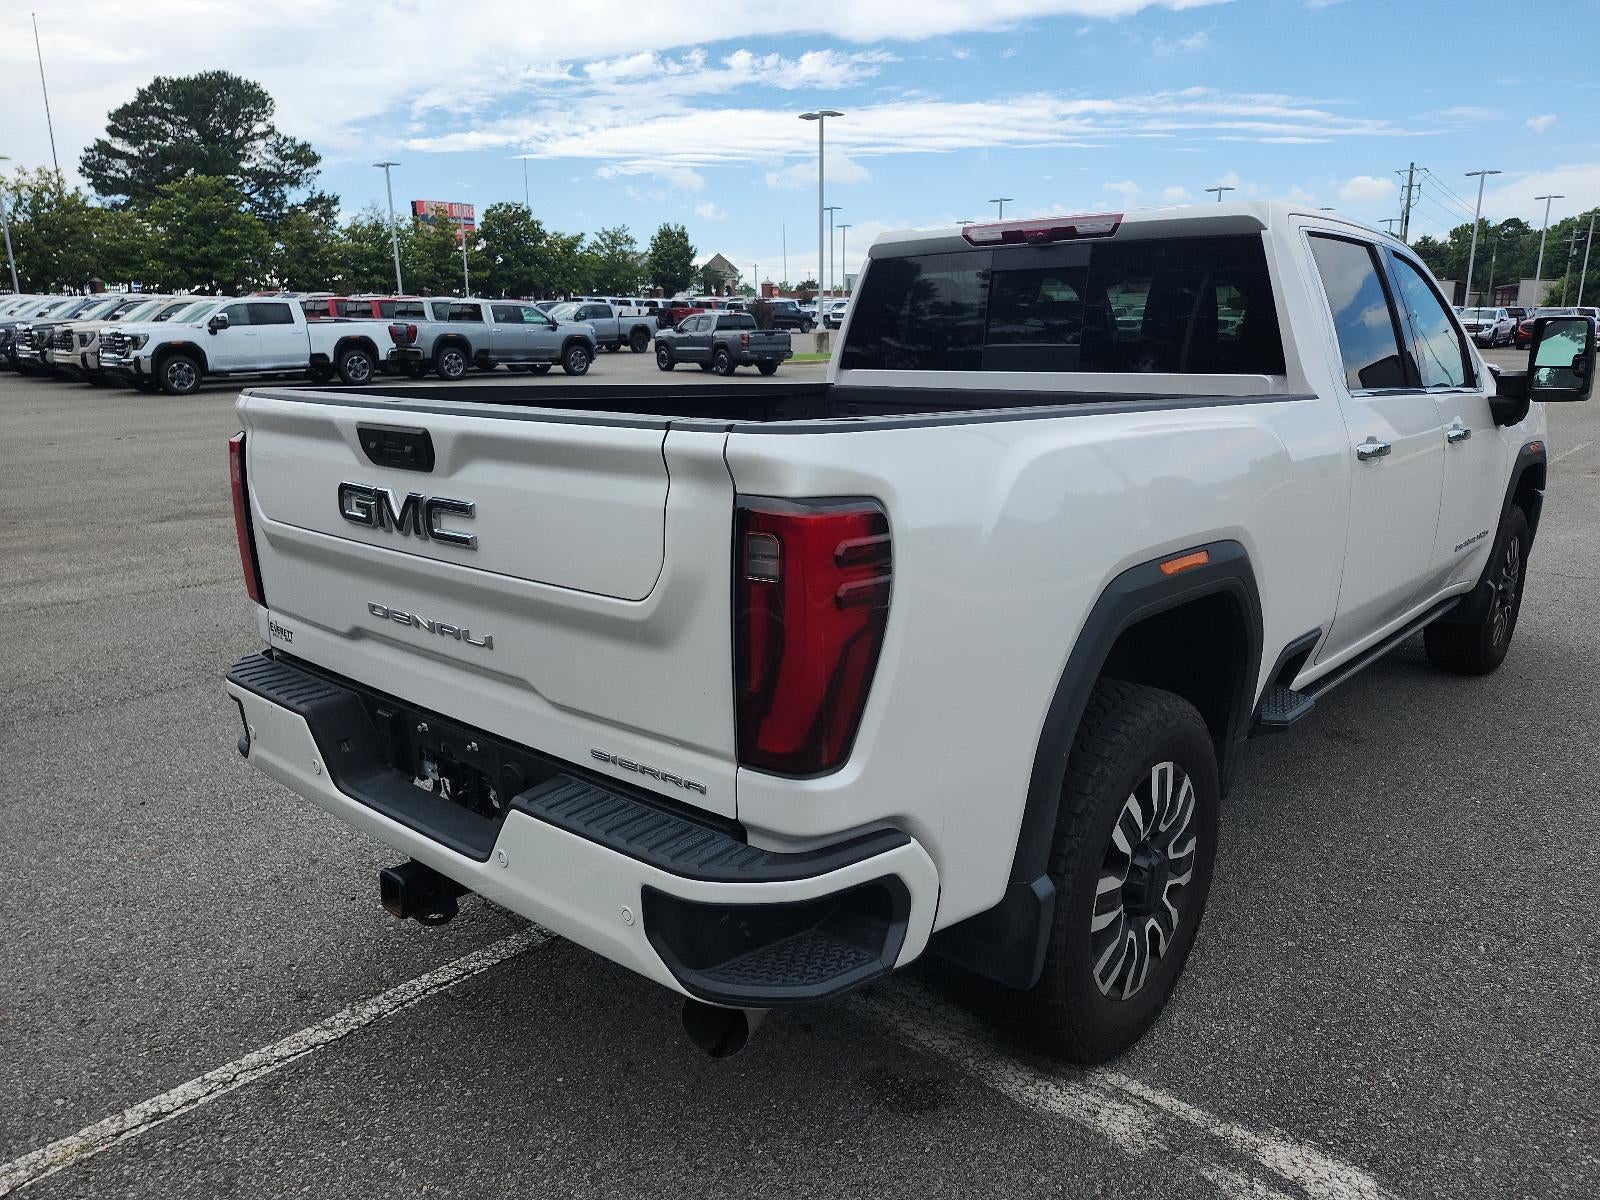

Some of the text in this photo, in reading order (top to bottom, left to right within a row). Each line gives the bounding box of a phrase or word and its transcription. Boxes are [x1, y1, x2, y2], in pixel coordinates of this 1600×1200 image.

[337, 480, 478, 551] GMC
[269, 620, 294, 640] EVERETT
[367, 600, 494, 650] DENALI
[590, 748, 707, 795] SIERRA
